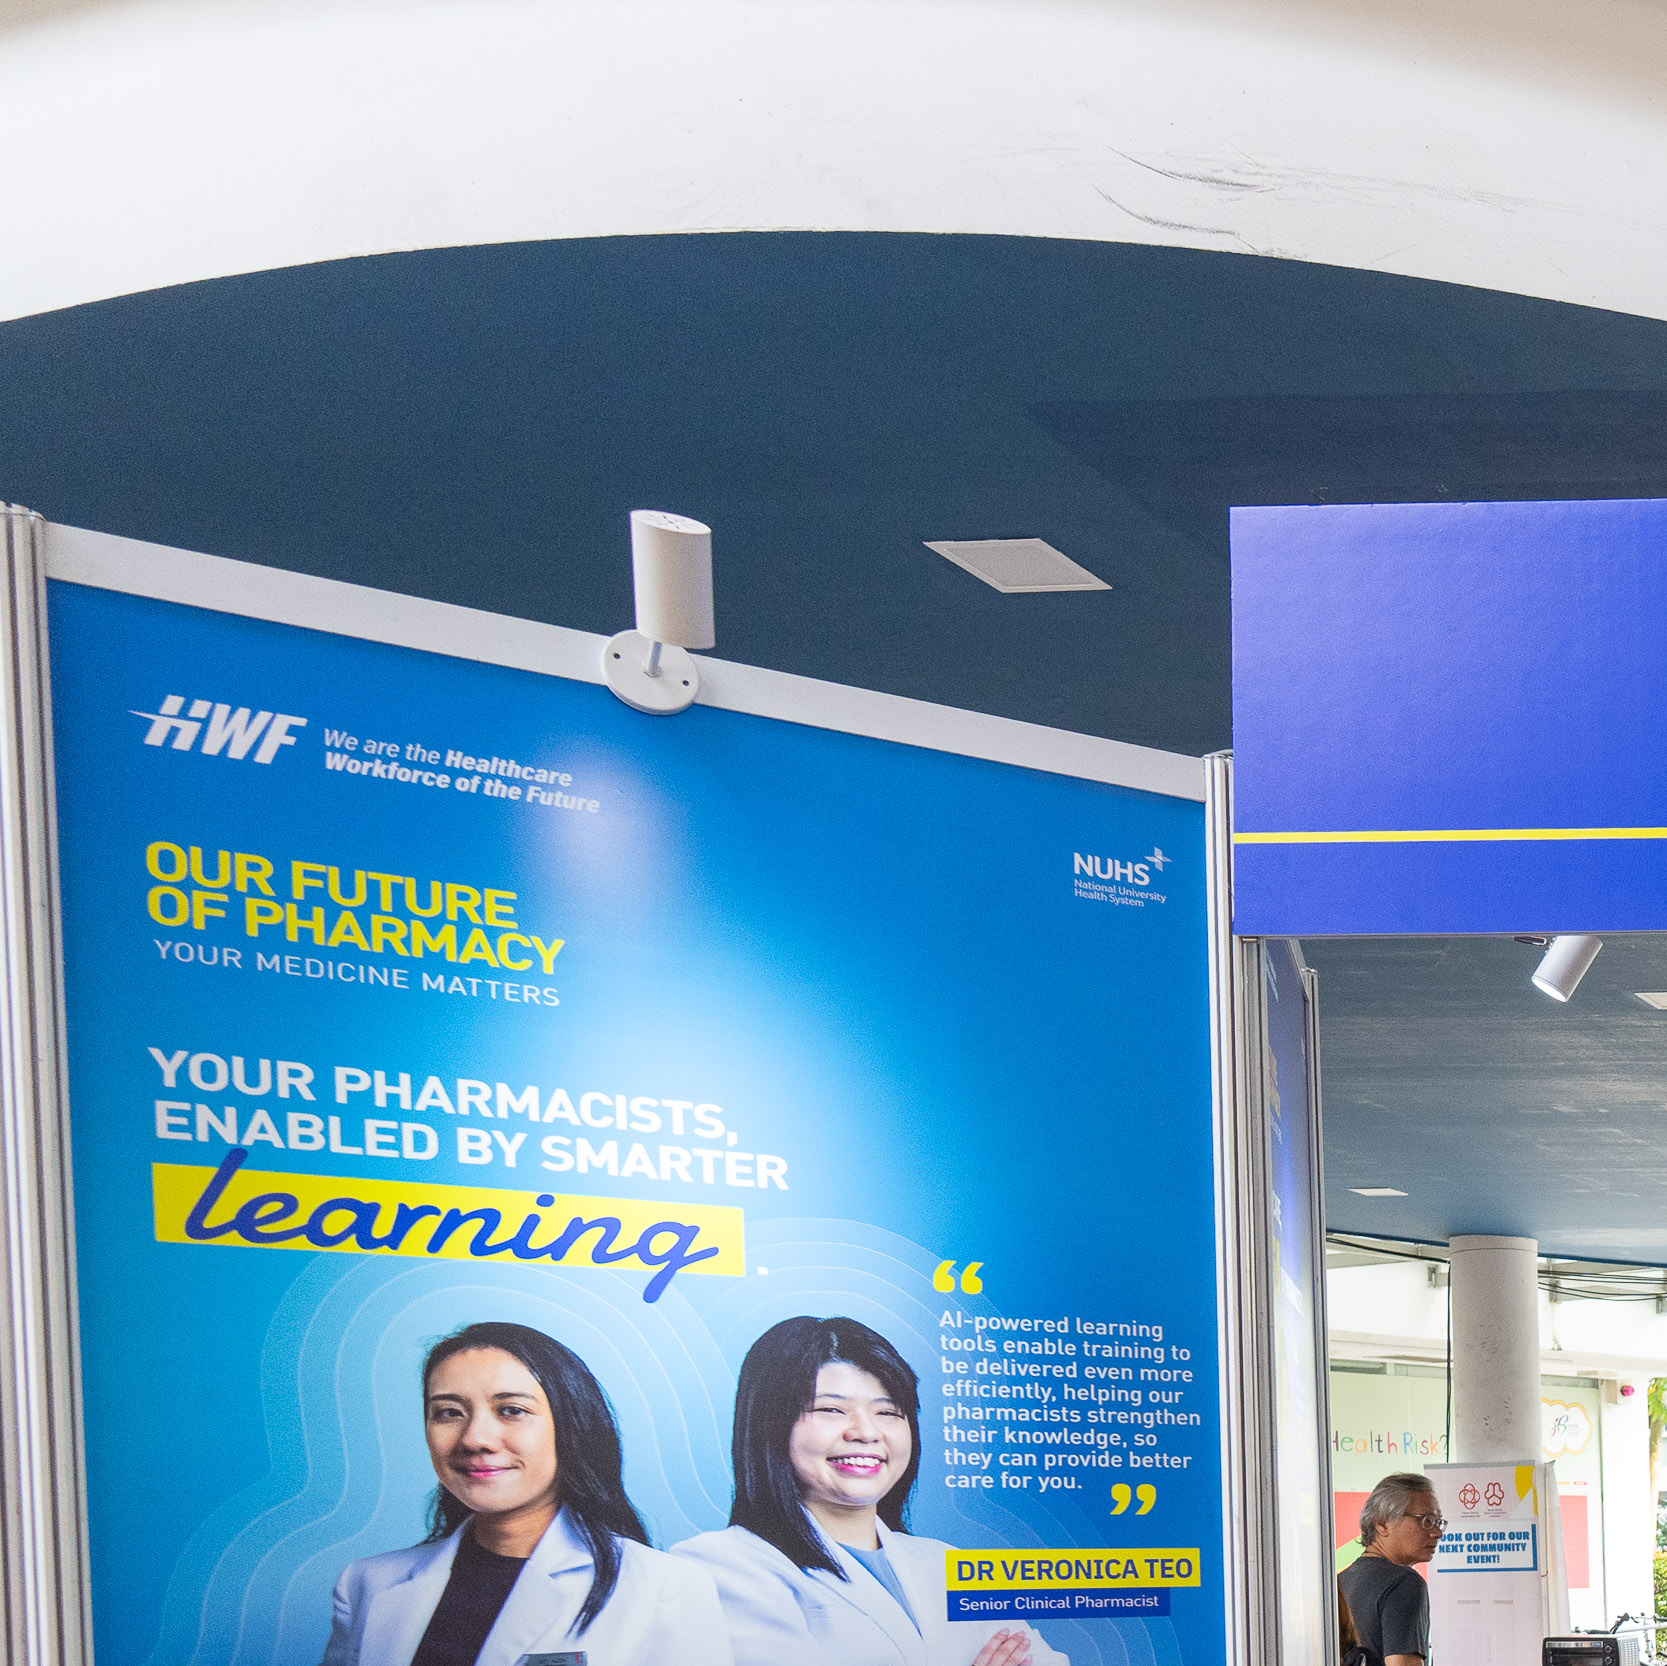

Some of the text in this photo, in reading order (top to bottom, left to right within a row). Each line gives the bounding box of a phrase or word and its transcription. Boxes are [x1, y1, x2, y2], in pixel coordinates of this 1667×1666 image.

[128, 695, 308, 765] HWF
[324, 728, 573, 788] We are the Healthcare
[325, 752, 600, 814] Workforce of the Future
[1074, 852, 1150, 886] NUHS
[145, 841, 519, 931] OUR FUTURE
[1074, 879, 1167, 904] National University
[1074, 888, 1144, 907] Health System
[146, 885, 566, 975] OF PHARMACY
[153, 938, 561, 1008] YOUR MEDICINE MATTERS
[147, 1046, 739, 1146] YOUR PHARMACISTS,
[154, 1098, 789, 1191] ENABLED BY SMARTER
[939, 1310, 1163, 1342] AI-powered learning
[940, 1333, 1191, 1363] tools enable training to
[1403, 1432, 1448, 1455] Risk?
[1439, 1531, 1529, 1541] OOK OUT FOR OUR
[1439, 1543, 1527, 1553] NEXT COMMUNITY
[957, 1558, 1193, 1582] DR VERONICA TEO
[1467, 1553, 1500, 1564] EVENT!
[959, 1594, 1159, 1612] Senior Clinical Pharmacist
